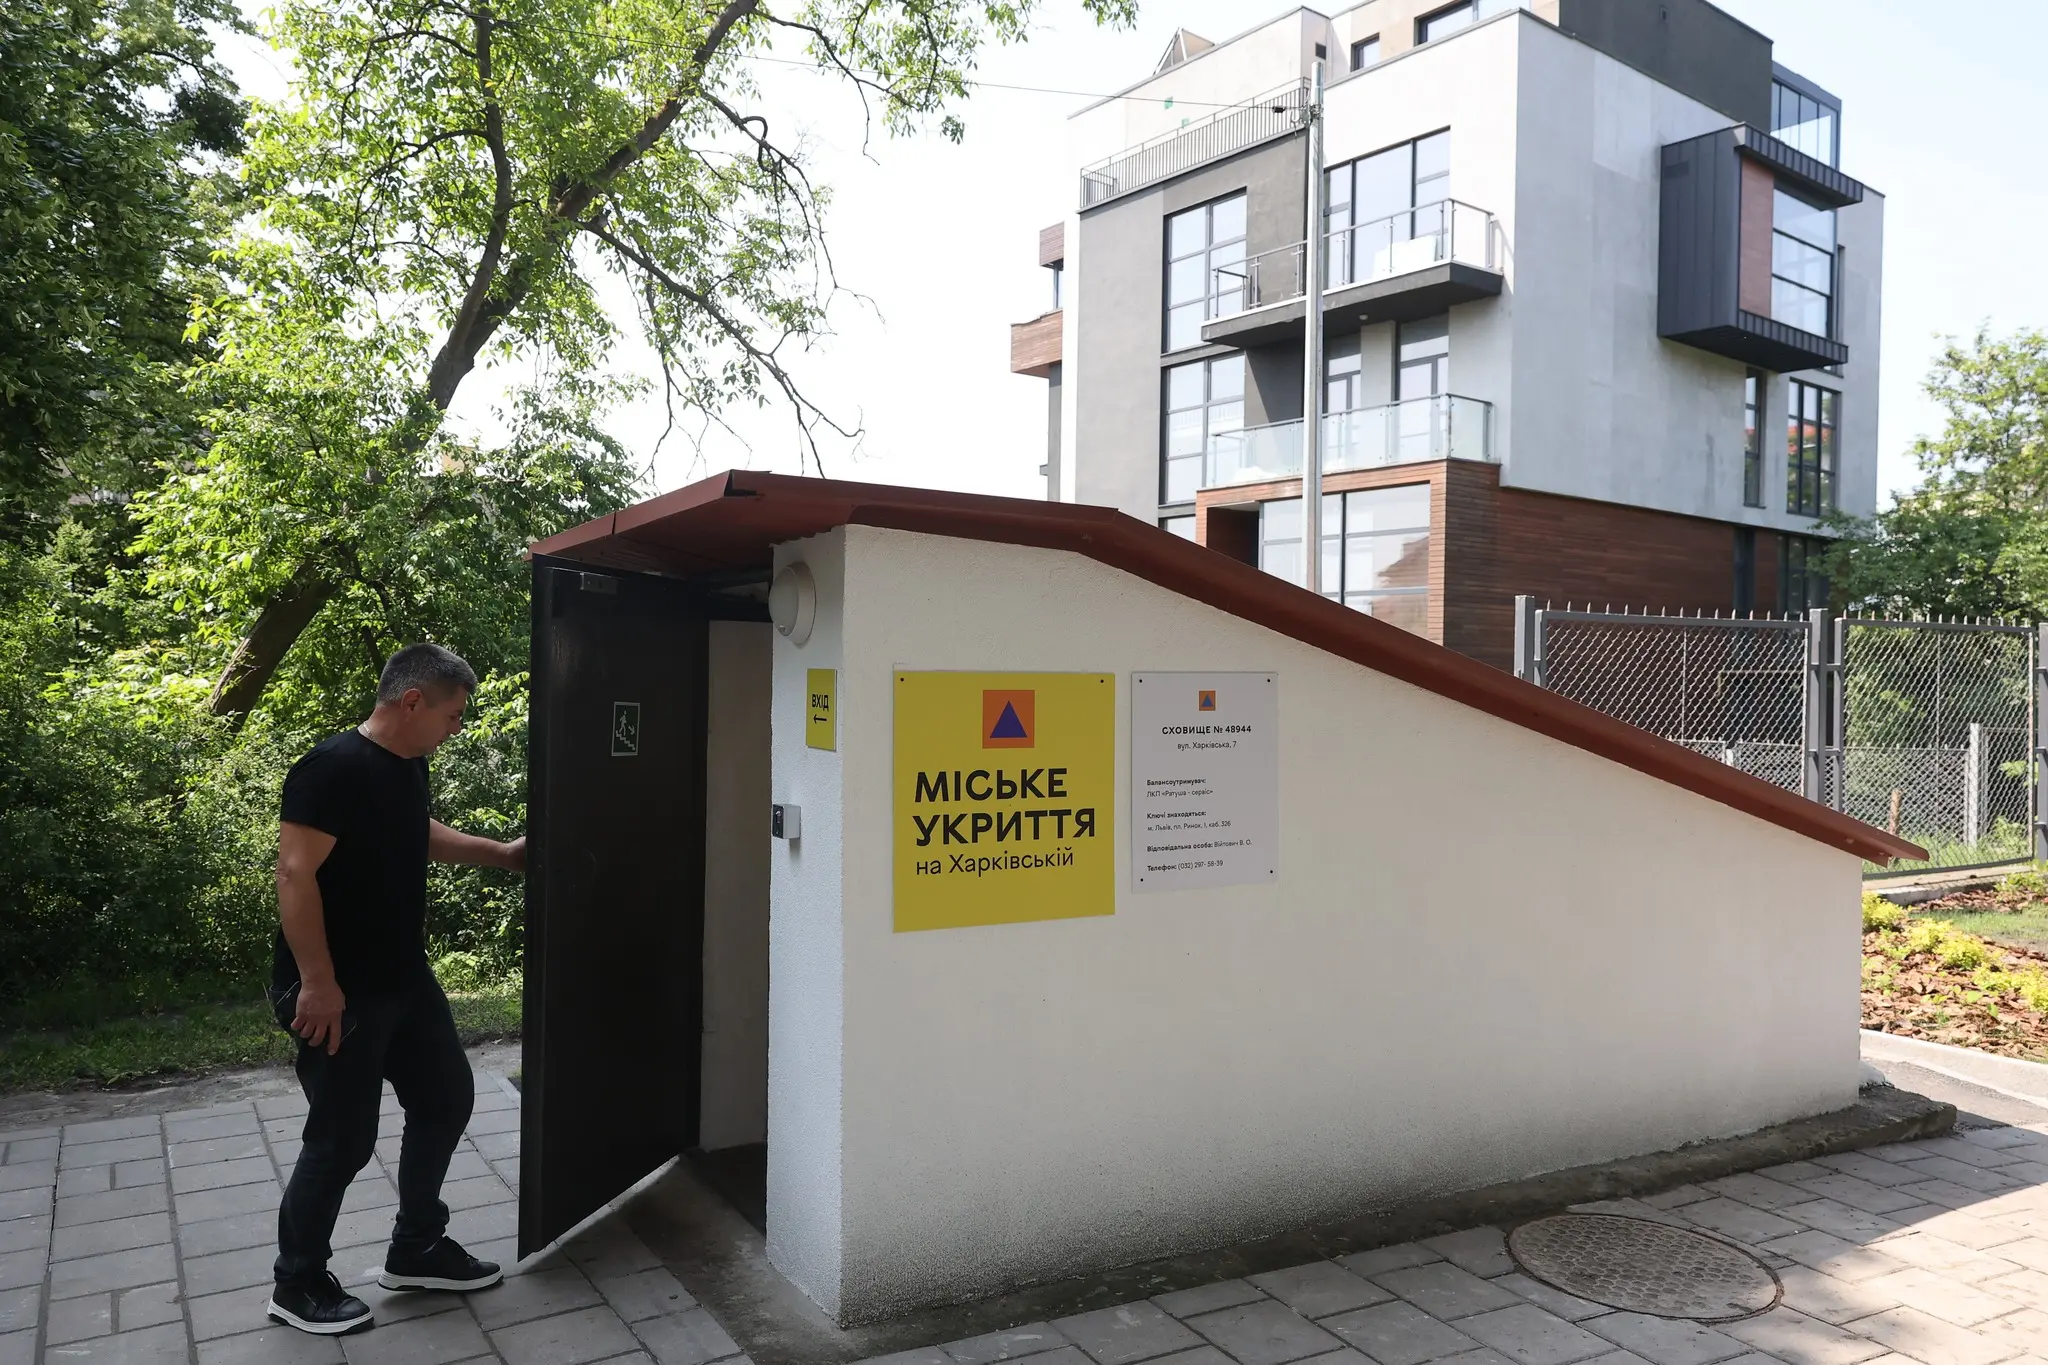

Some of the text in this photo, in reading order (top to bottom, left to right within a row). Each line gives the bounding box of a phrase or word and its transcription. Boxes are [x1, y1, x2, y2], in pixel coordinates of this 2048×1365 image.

[811, 693, 829, 712] ВХІД
[1161, 725, 1252, 735] СХОВИЩЕ № 48944
[1177, 743, 1191, 751] вул.
[1192, 741, 1232, 750] Харківська,
[914, 768, 1067, 803] МІСЬКЕ
[1161, 790, 1186, 798] «Ратуша
[1167, 811, 1206, 819] знаходяться:
[912, 808, 1095, 847] УКРИТТЯ
[1146, 844, 1192, 852] Відповідальна
[917, 846, 1073, 877] на Харківській
[1147, 863, 1177, 872] Телефон:
[1177, 861, 1194, 870] (032)
